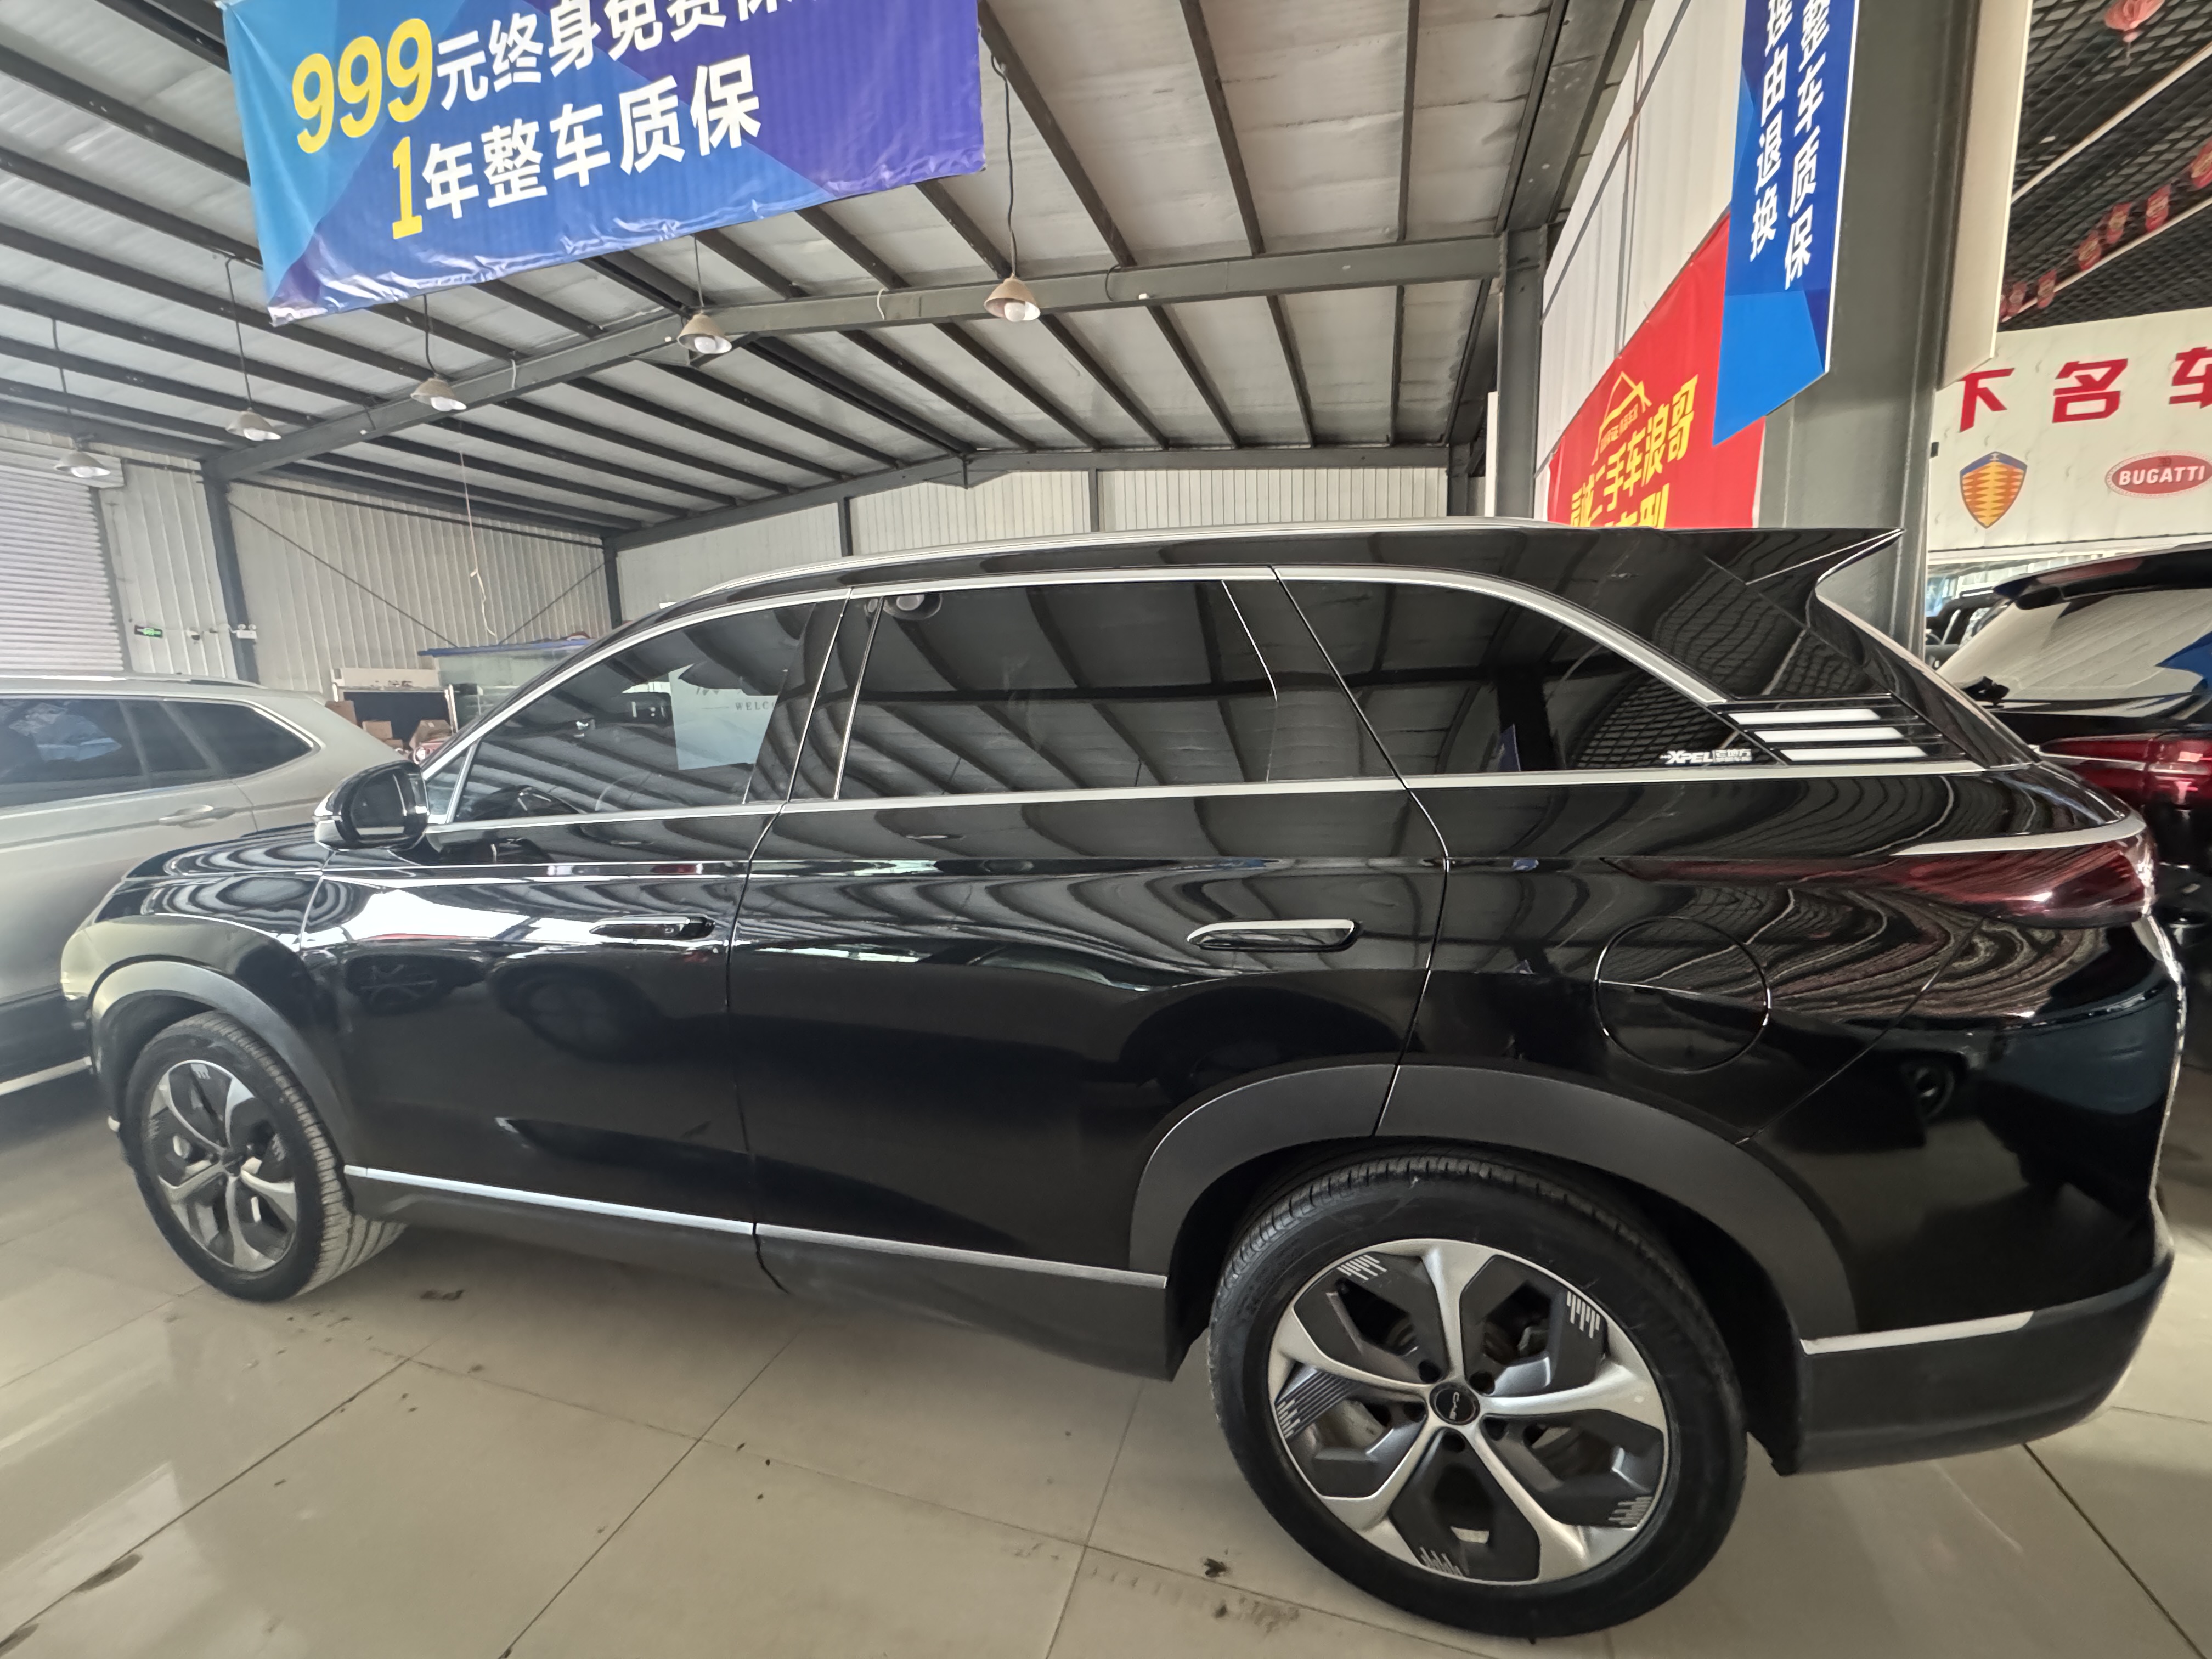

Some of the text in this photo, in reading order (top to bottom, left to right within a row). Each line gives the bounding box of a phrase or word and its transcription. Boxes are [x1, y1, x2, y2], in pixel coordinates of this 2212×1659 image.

[392, 54, 762, 240] 1年整车质保
[2118, 465, 2205, 486] BUGATTI
[735, 701, 775, 712] WELC
[1664, 750, 1713, 764] XPEL
